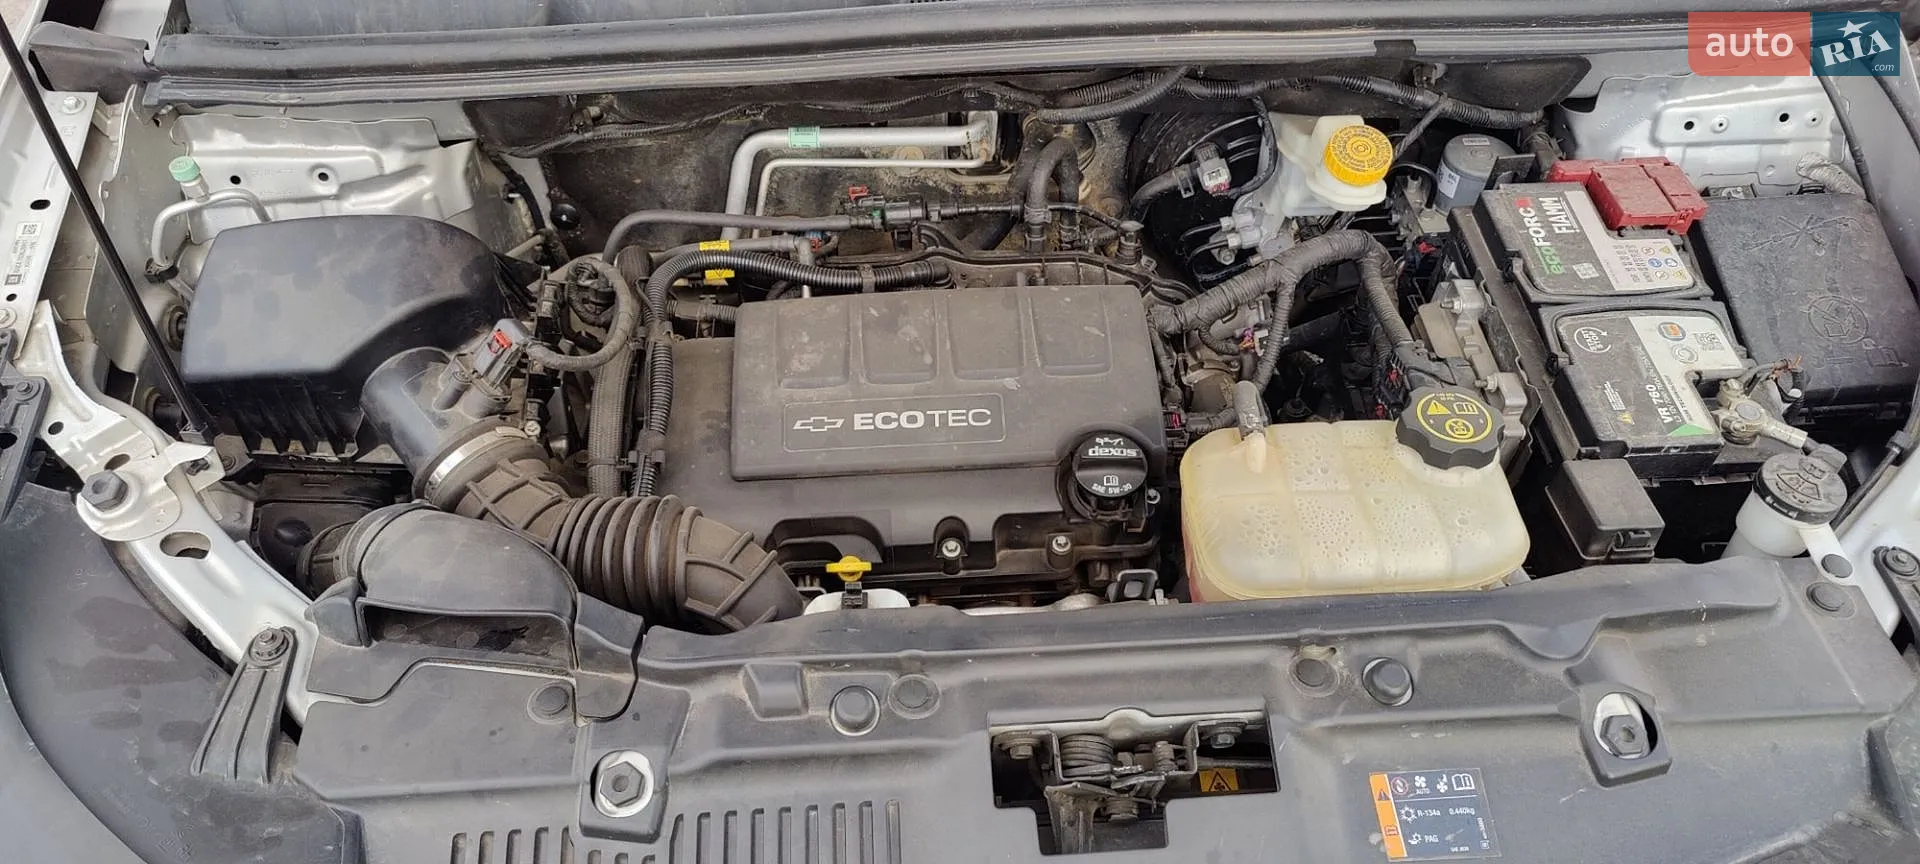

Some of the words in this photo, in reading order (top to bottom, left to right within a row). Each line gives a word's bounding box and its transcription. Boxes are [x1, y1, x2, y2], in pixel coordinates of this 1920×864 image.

[1538, 197, 1575, 234] FIAMM
[1581, 330, 1598, 351] START
[1588, 330, 1604, 350] STOP
[1645, 384, 1663, 405] 760
[853, 408, 992, 430] ECOTEC
[1657, 407, 1674, 424] VR
[1088, 446, 1138, 457] dexos
[1424, 834, 1440, 843] PAG
